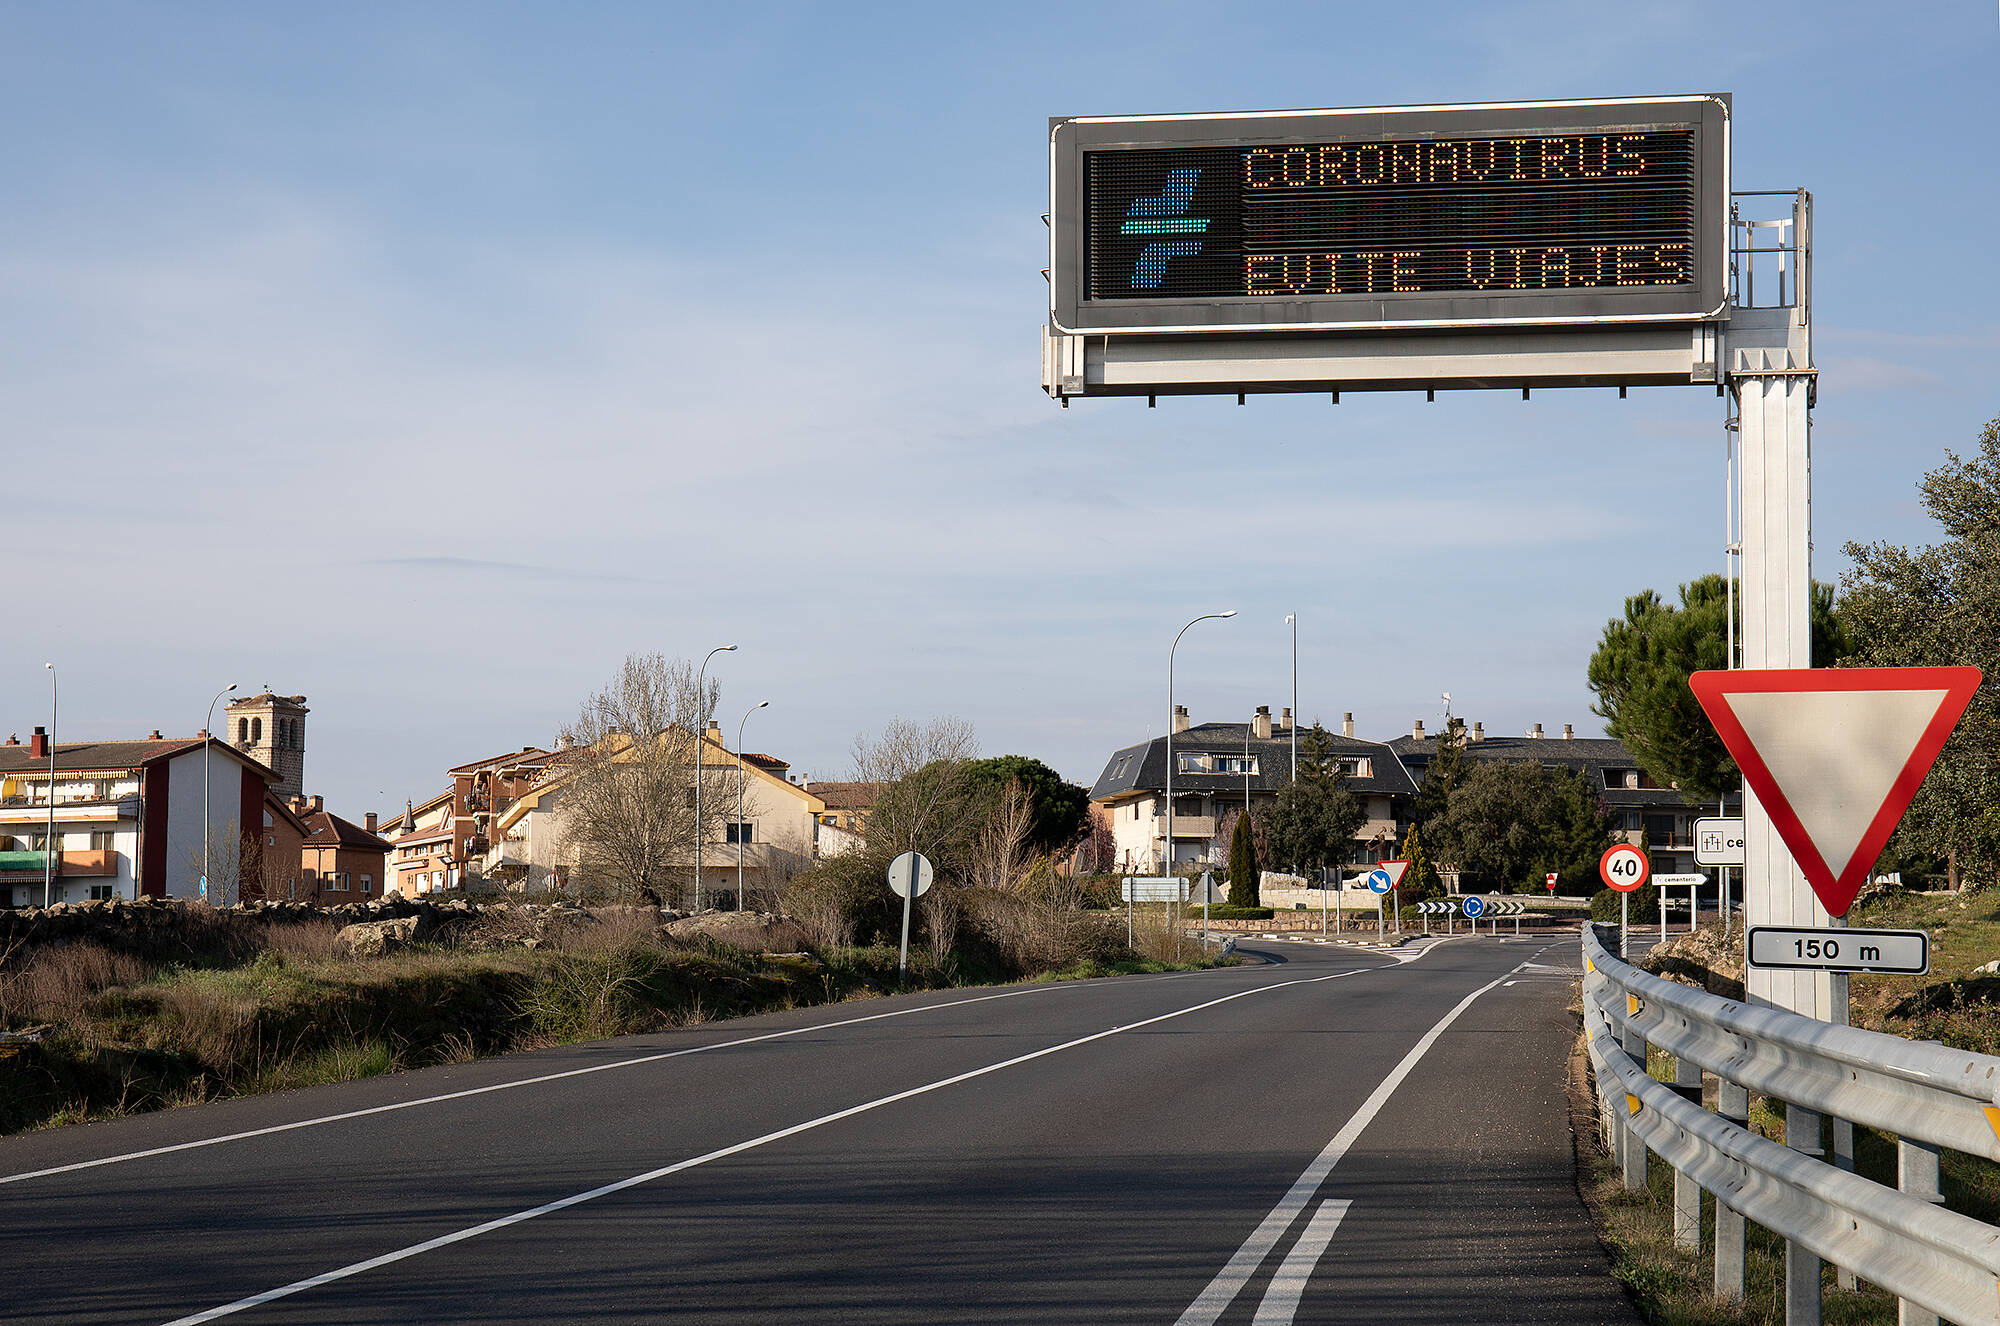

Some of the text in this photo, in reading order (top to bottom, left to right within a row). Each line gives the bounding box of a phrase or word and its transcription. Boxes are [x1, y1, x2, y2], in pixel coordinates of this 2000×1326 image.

[1245, 135, 1645, 188] CORONAVIRUS
[1246, 243, 1685, 296] EVITE VIAJES
[1612, 859, 1637, 877] 40
[1795, 939, 1881, 961] 150 m
